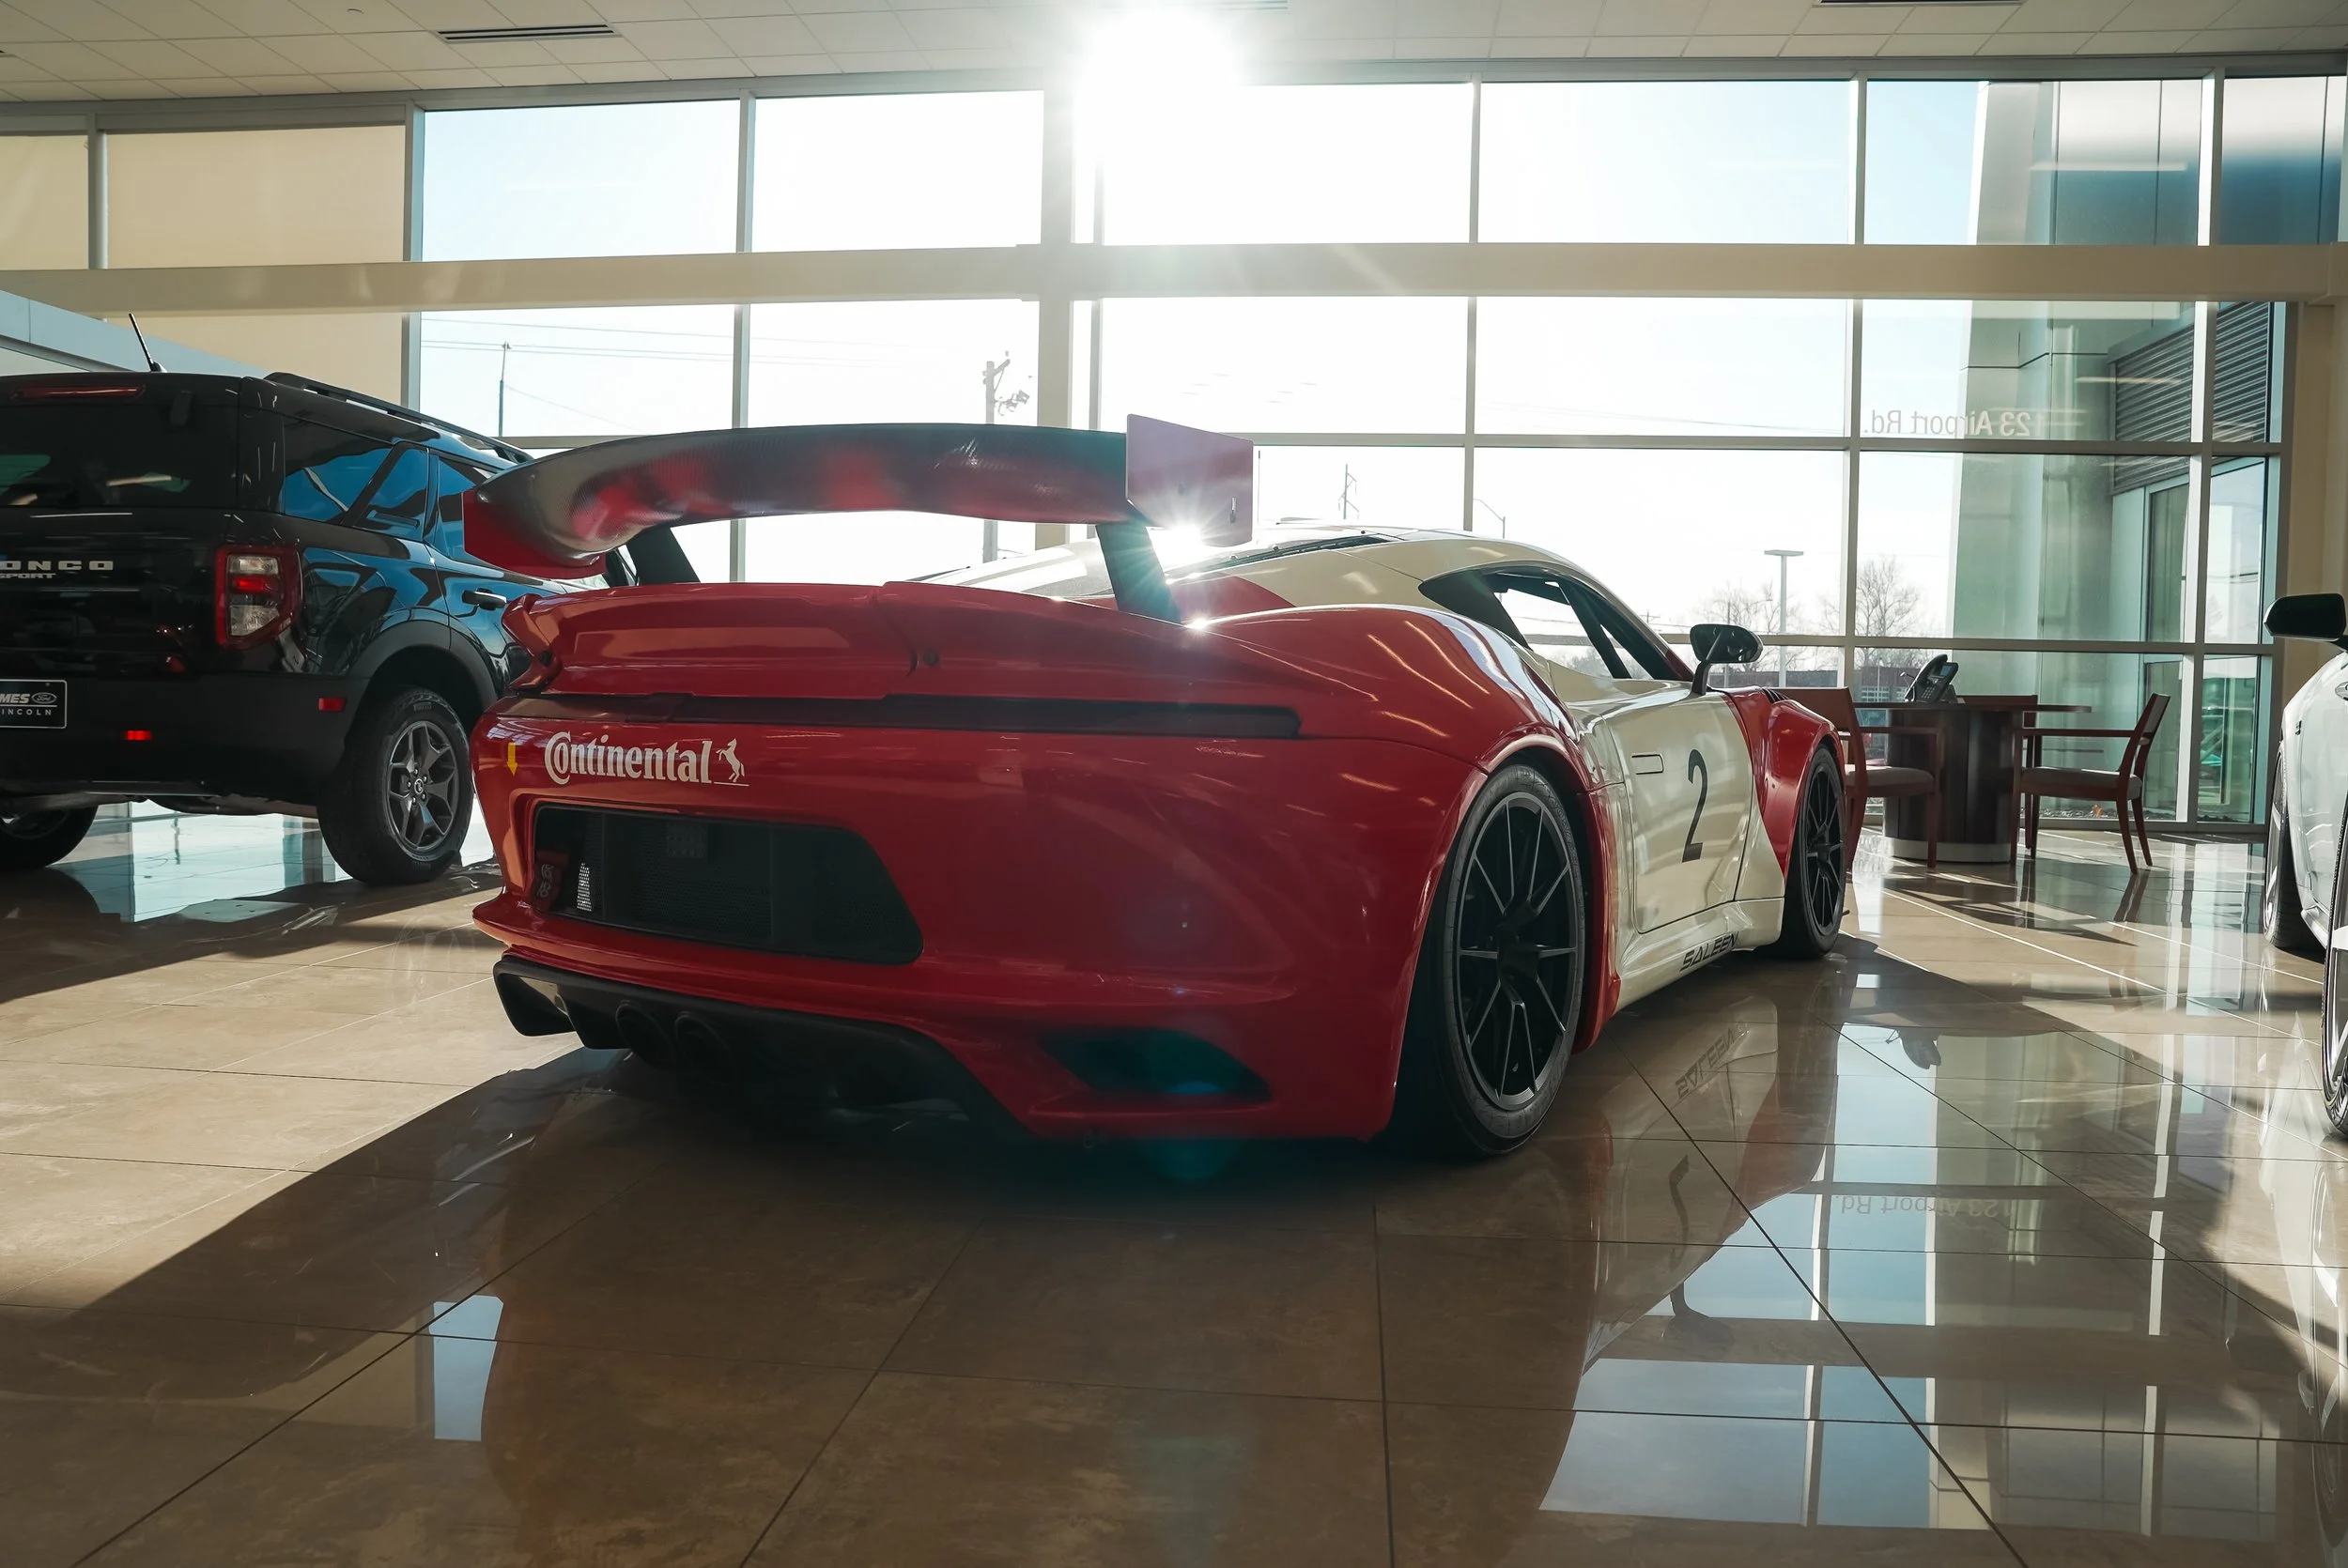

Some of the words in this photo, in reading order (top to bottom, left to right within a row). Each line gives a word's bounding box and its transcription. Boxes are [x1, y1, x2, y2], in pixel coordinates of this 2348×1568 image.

[544, 730, 713, 785] Continental
[1681, 748, 1708, 863] 2
[1679, 931, 1738, 971] SALEEN
